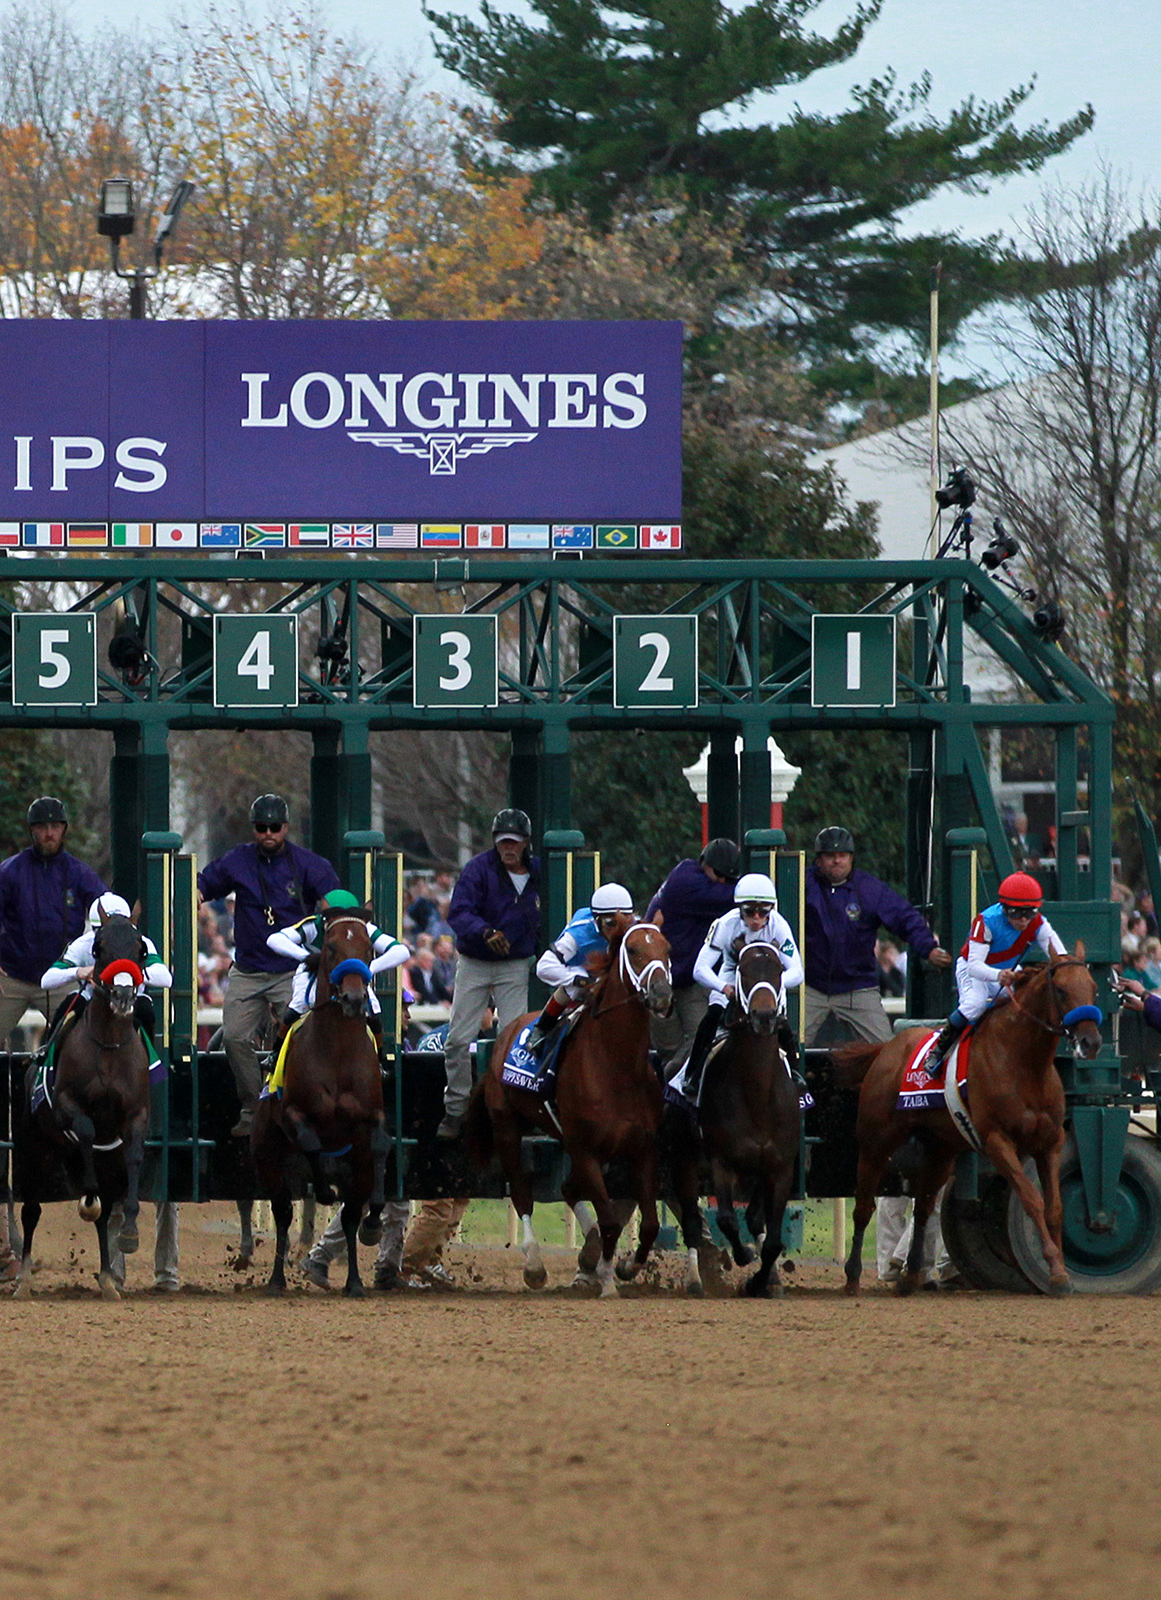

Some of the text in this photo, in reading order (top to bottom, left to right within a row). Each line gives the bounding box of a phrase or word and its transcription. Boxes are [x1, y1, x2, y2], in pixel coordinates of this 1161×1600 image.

[242, 373, 647, 429] LONGINES
[39, 630, 70, 688] 5
[238, 631, 274, 689] 4
[440, 632, 471, 690] 3
[639, 633, 673, 690] 2
[847, 632, 860, 689] 1
[973, 921, 981, 938] 1
[902, 1095, 929, 1108] TAIBA
